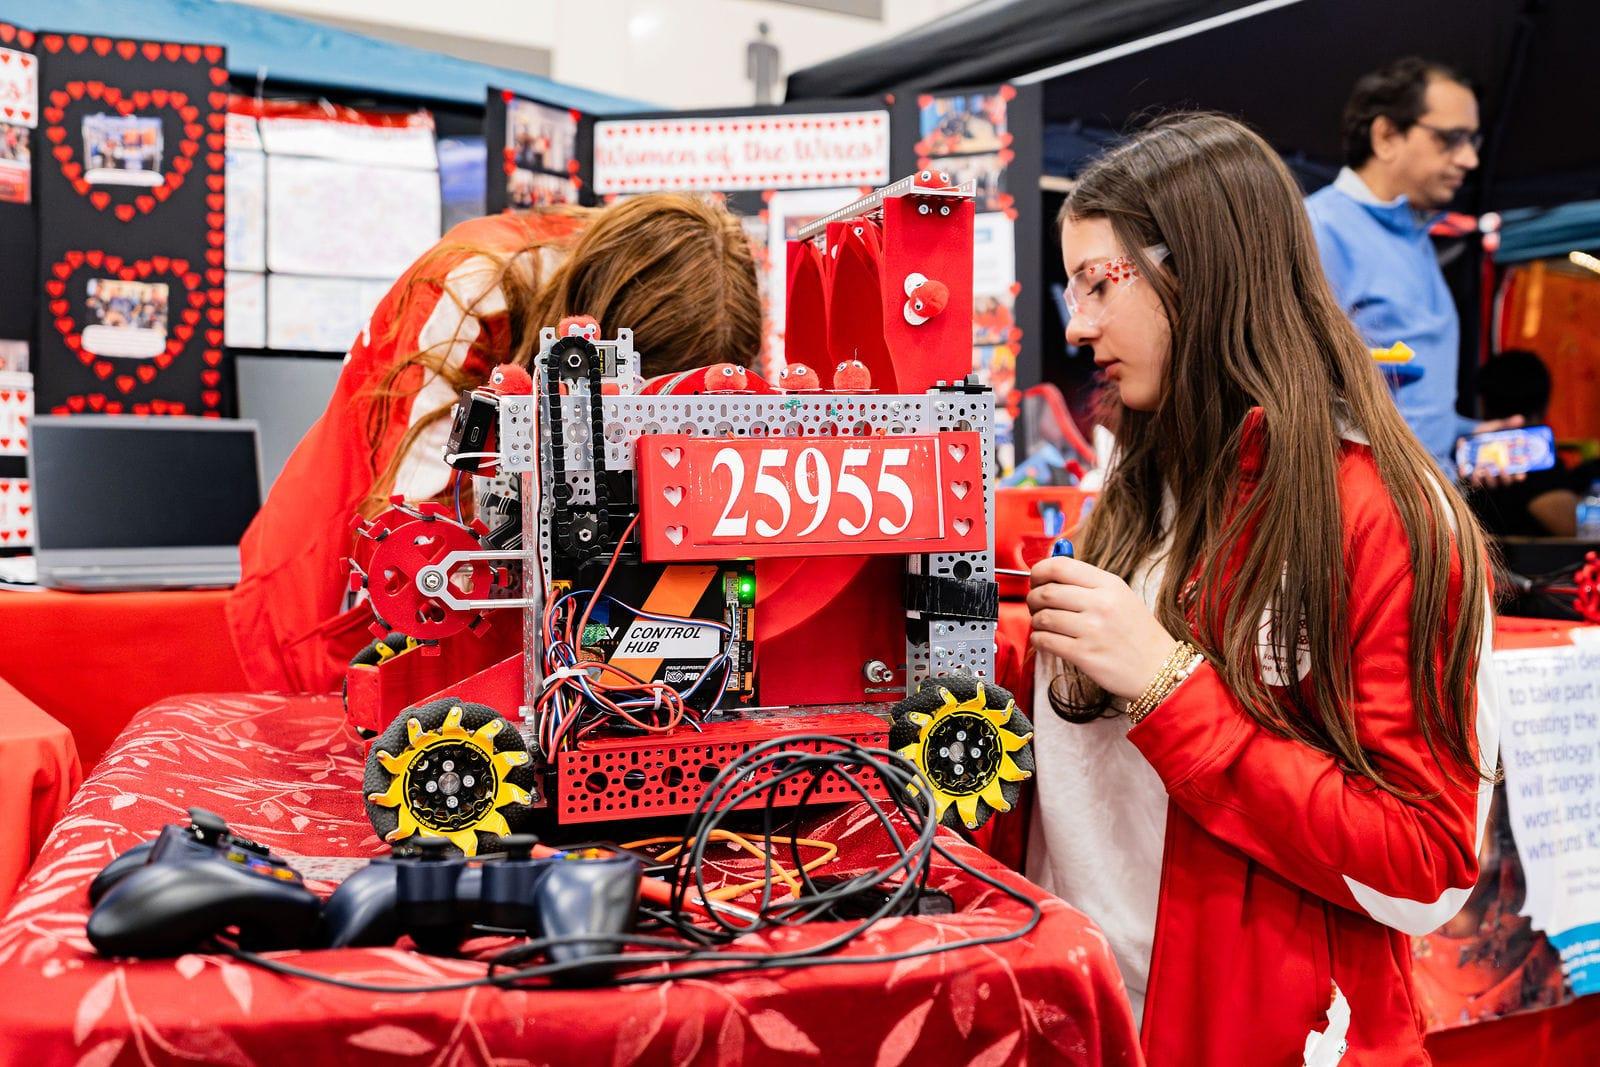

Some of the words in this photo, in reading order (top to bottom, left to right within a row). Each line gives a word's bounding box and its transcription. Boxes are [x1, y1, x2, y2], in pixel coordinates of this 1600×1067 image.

[596, 143, 698, 168] Women
[704, 143, 733, 174] of
[743, 140, 786, 164] the
[711, 447, 914, 538] 25955
[630, 626, 702, 640] CONTROL
[624, 641, 660, 653] HUB
[684, 672, 701, 681] FIR
[1509, 688, 1526, 706] to
[1529, 683, 1561, 703] take
[1565, 683, 1595, 705] part
[1574, 710, 1598, 730] the
